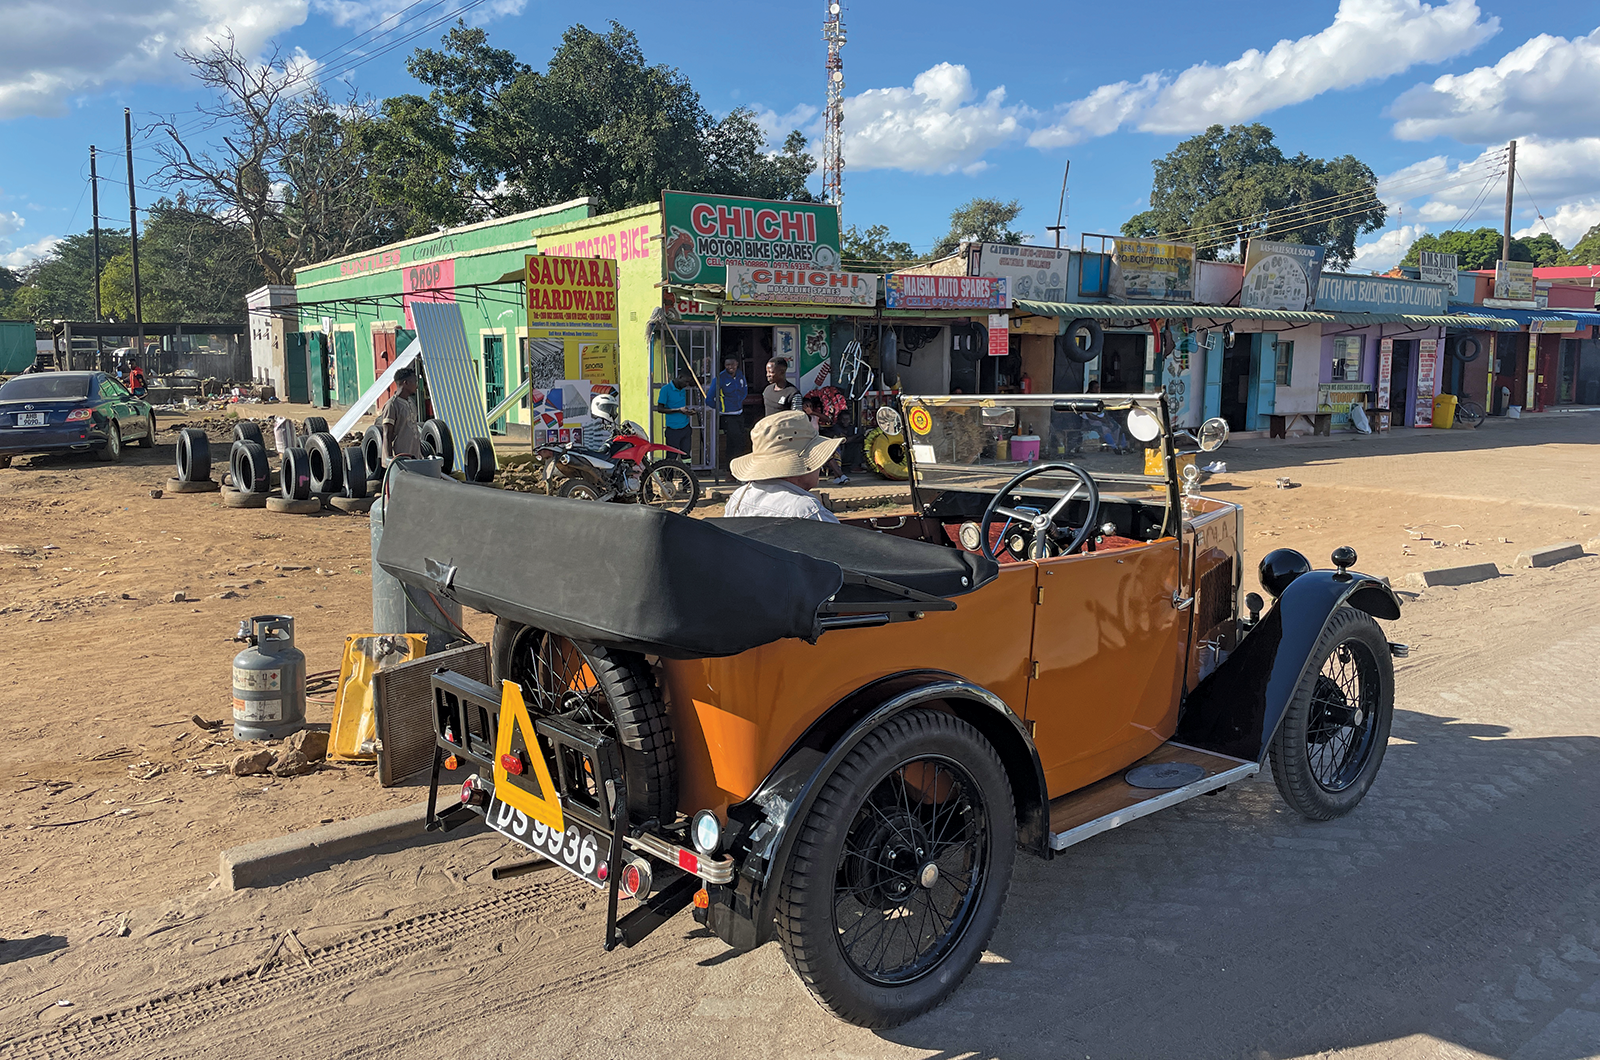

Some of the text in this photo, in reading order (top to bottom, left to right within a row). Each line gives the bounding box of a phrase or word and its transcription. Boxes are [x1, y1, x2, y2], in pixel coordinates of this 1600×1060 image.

[692, 204, 816, 243] CHICHI
[620, 225, 649, 261] BIKE
[699, 238, 813, 261] MOTOR BIKE SPARES
[529, 256, 614, 287] SAUVARA
[707, 257, 724, 266] CELL:
[410, 264, 440, 291] DROP
[752, 269, 859, 288] CHICHI
[904, 276, 990, 298] MAISHA AUTO SPARES
[529, 288, 615, 311] HARDWARE
[812, 287, 841, 296] SPARES
[906, 297, 931, 306] CELL:
[1358, 281, 1398, 306] BUSINESS
[1399, 285, 1442, 309] SOLUTIONS
[497, 801, 598, 872] DS 9936
